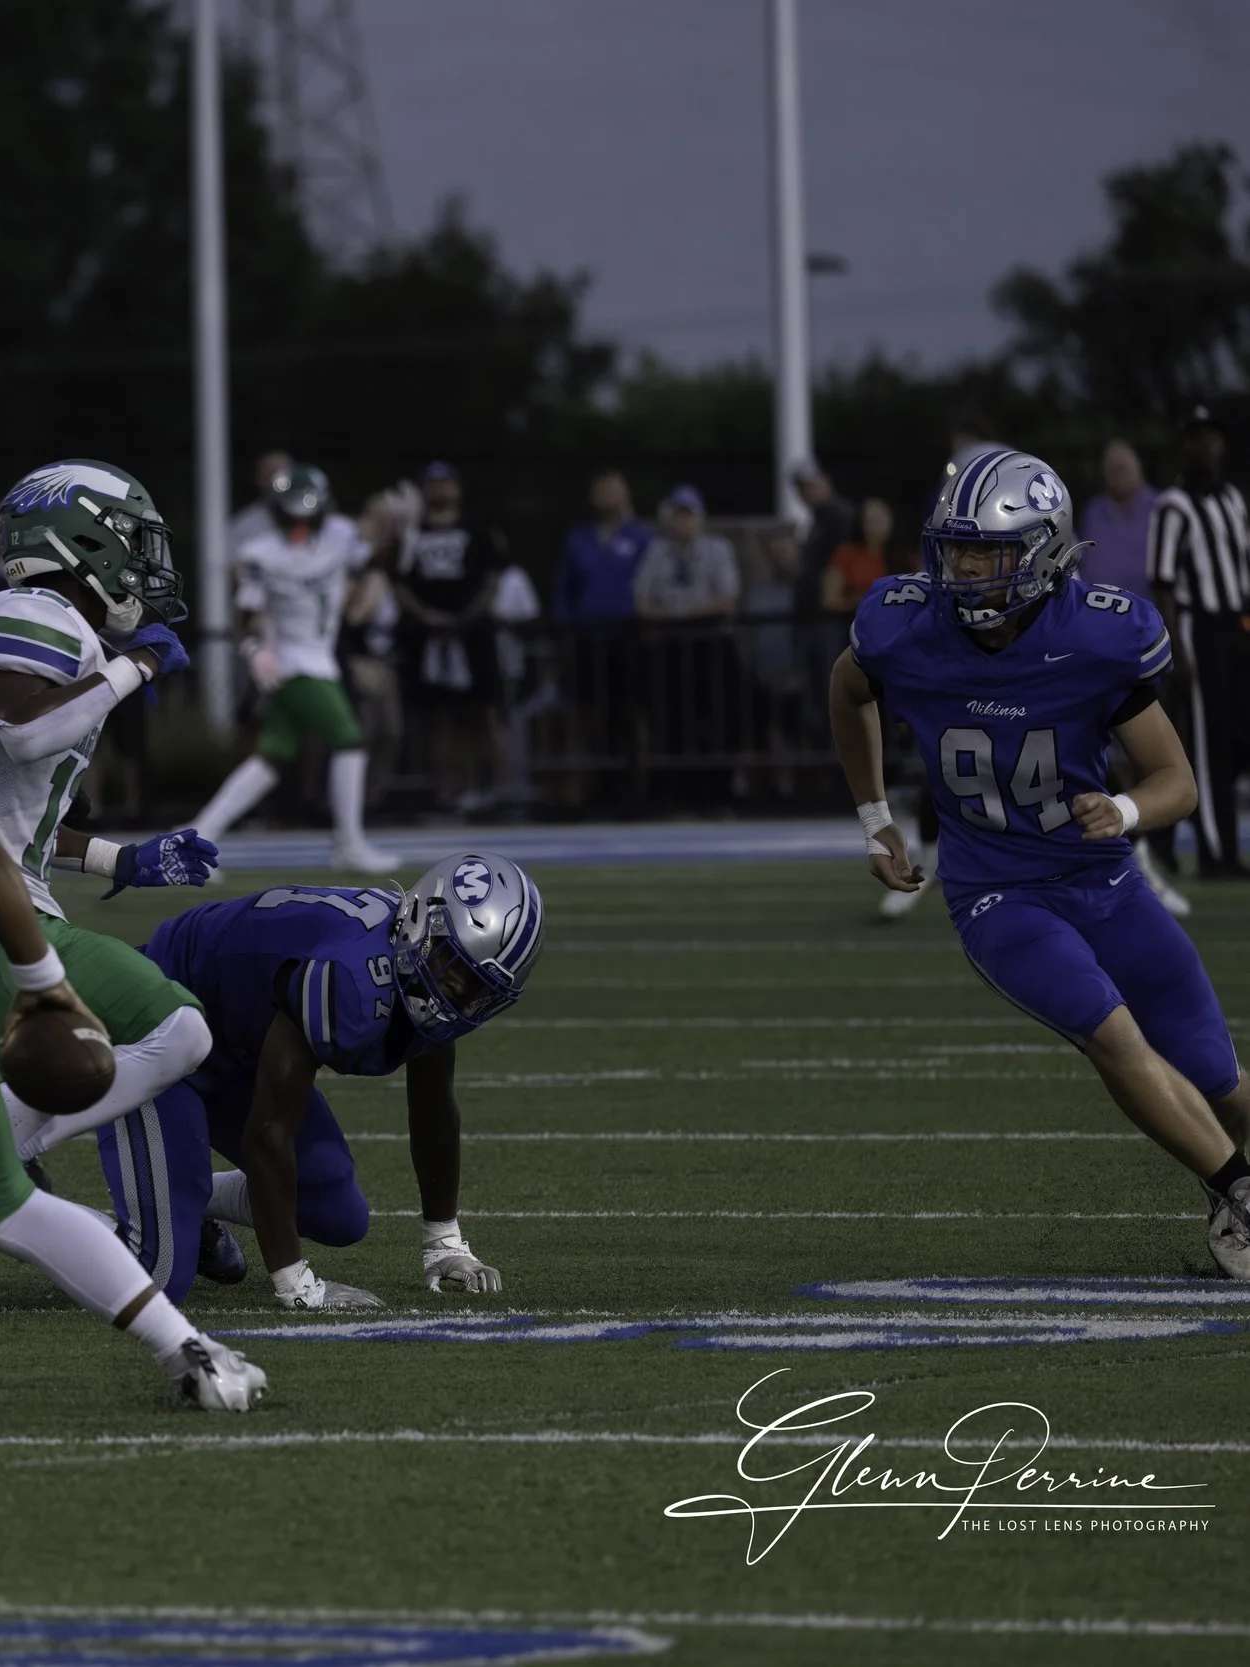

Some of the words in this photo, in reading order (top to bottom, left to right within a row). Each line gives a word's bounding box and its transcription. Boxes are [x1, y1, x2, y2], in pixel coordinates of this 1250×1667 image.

[1029, 473, 1063, 512] M
[966, 700, 1028, 720] Vikings
[939, 727, 1073, 835] 94
[22, 755, 86, 884] 1
[453, 861, 491, 904] M
